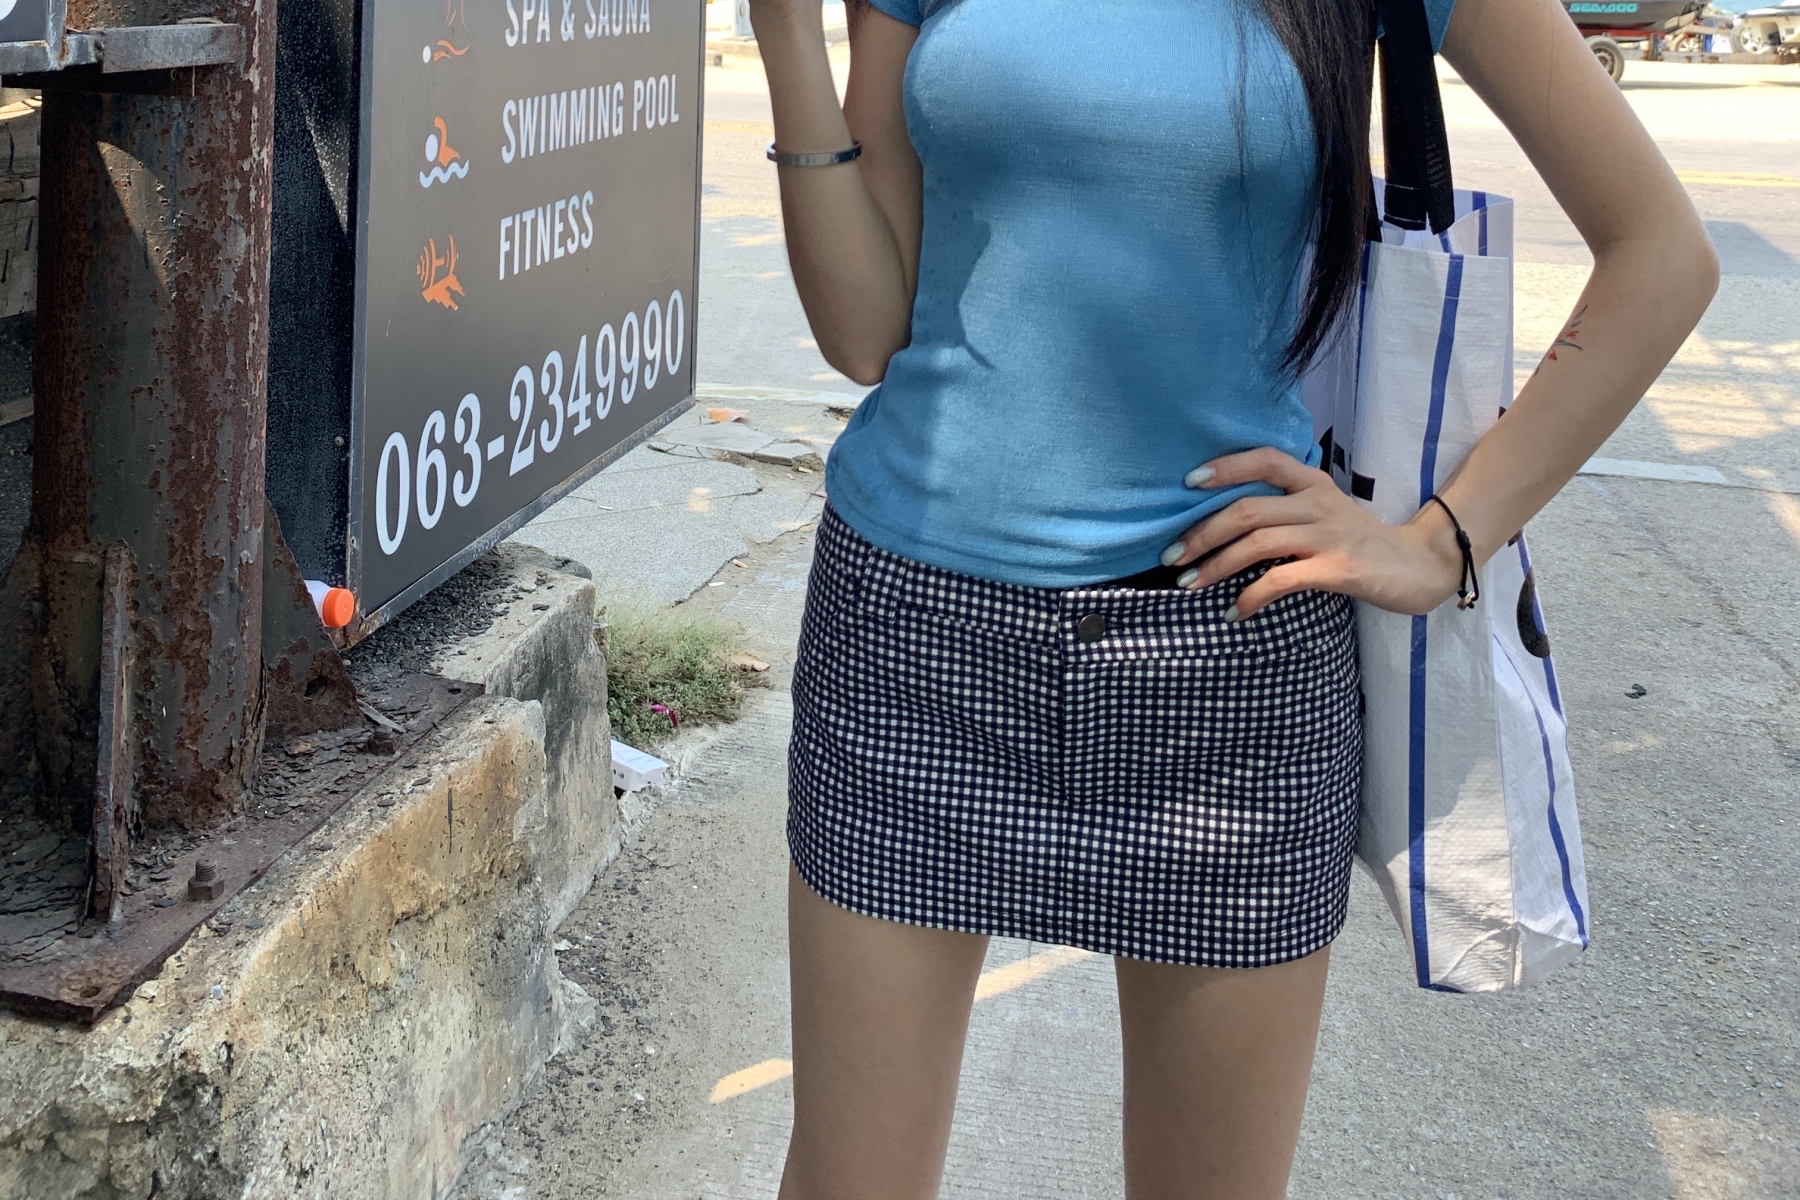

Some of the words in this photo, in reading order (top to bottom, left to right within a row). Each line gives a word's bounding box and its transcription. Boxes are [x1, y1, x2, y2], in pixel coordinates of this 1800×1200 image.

[501, 81, 625, 164] SWIMMING
[633, 73, 680, 132] POOL
[500, 189, 595, 281] FITNESS
[375, 289, 685, 556] 063-2349990
